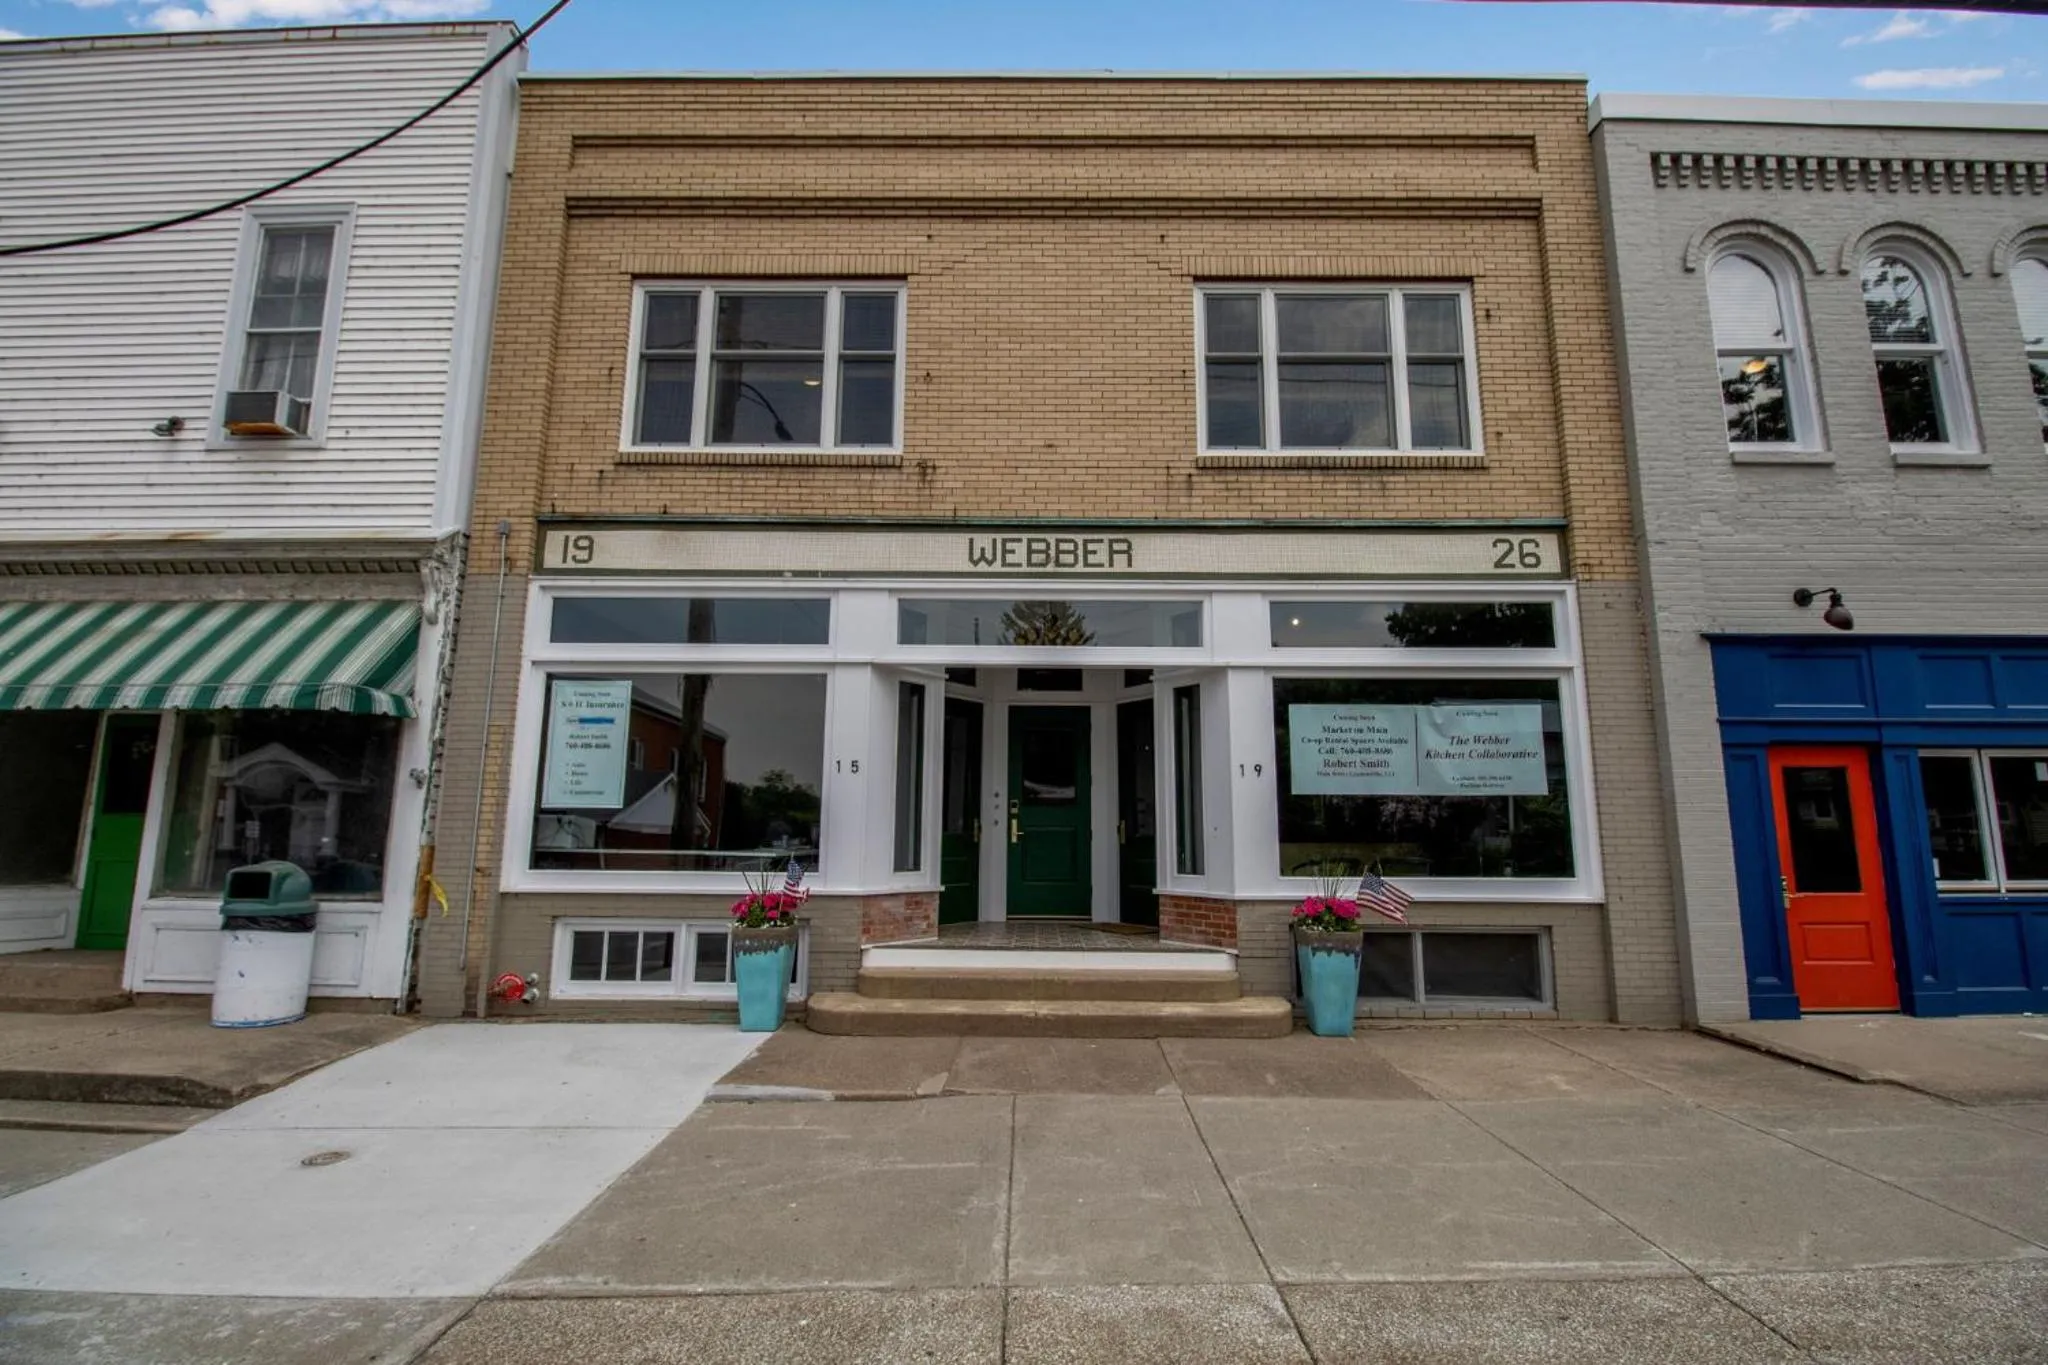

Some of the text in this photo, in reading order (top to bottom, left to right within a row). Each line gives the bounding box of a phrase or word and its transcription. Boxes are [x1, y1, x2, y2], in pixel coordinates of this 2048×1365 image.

[562, 535, 1541, 568] 19 WEBBER 26
[1322, 726, 1352, 734] Market
[1450, 735, 1511, 745] The Webber
[1425, 749, 1539, 760] Kitchen Collaborative
[1323, 759, 1389, 768] Robert Smith
